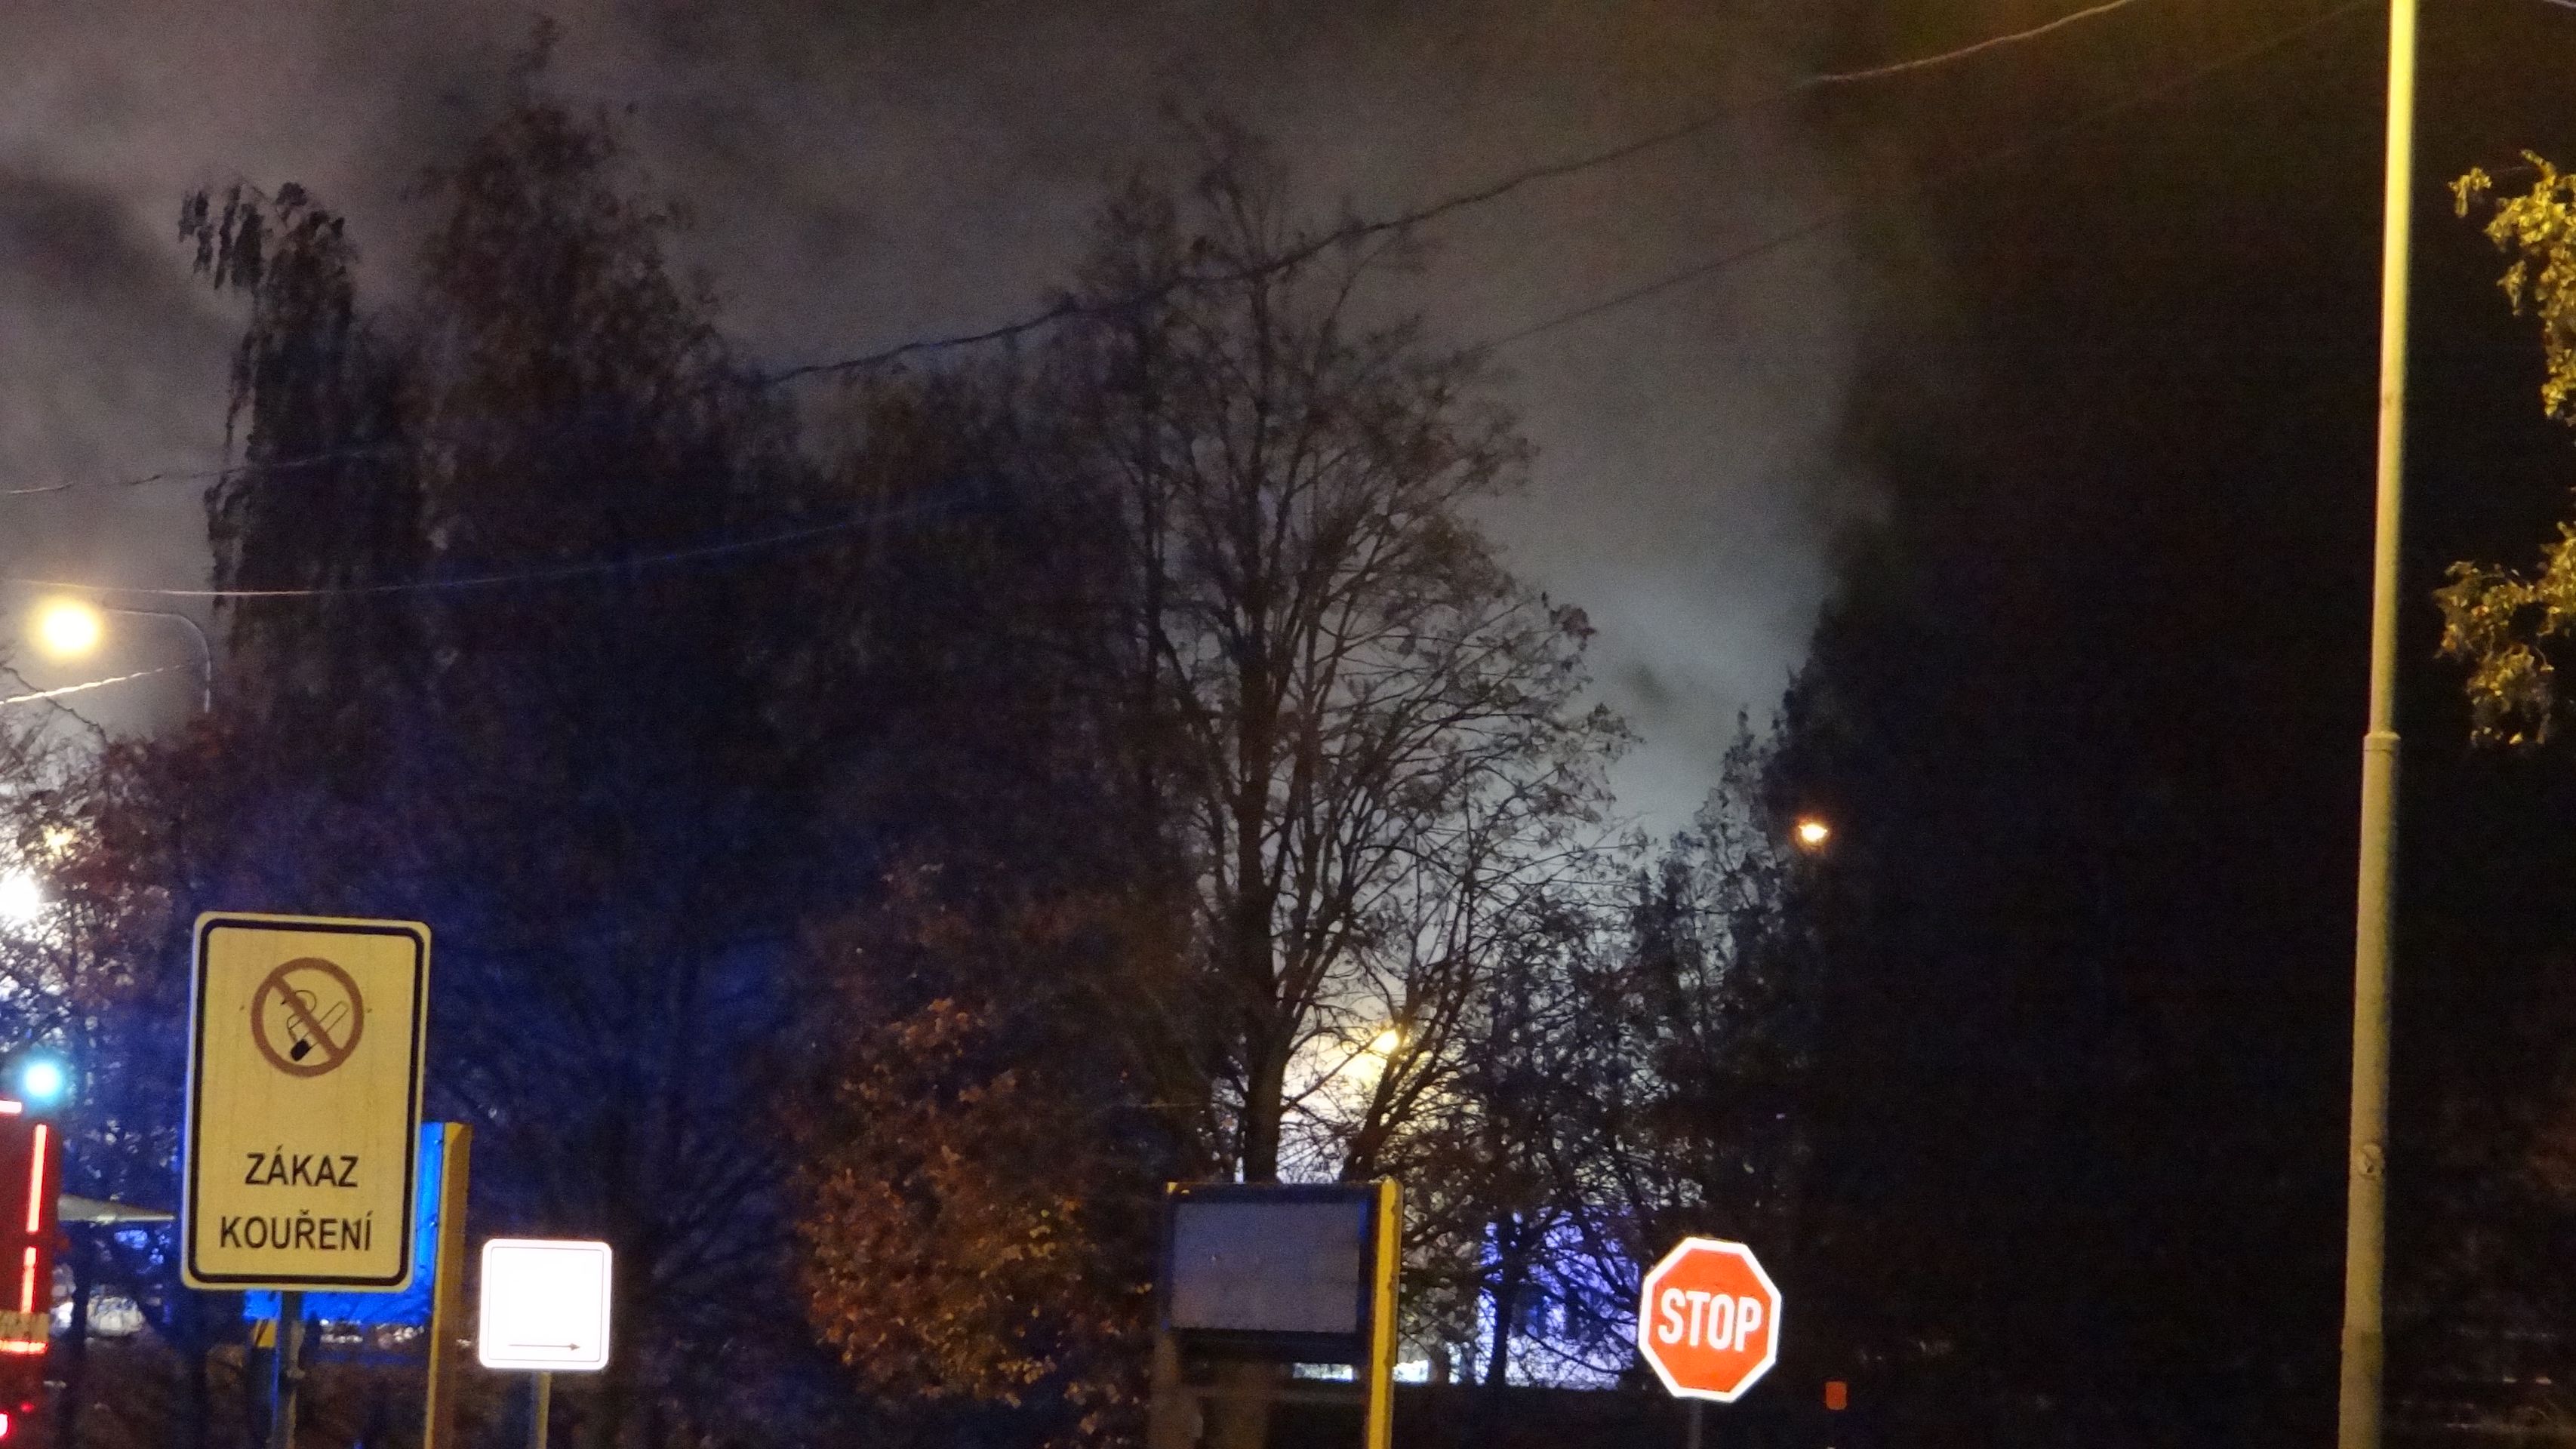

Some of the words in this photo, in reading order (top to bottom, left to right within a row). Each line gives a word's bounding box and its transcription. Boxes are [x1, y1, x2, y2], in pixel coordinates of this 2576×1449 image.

[245, 1144, 359, 1187] ZÁKAZ
[220, 1209, 373, 1251] KOUŘENÍ
[1657, 1287, 1763, 1352] STOP
